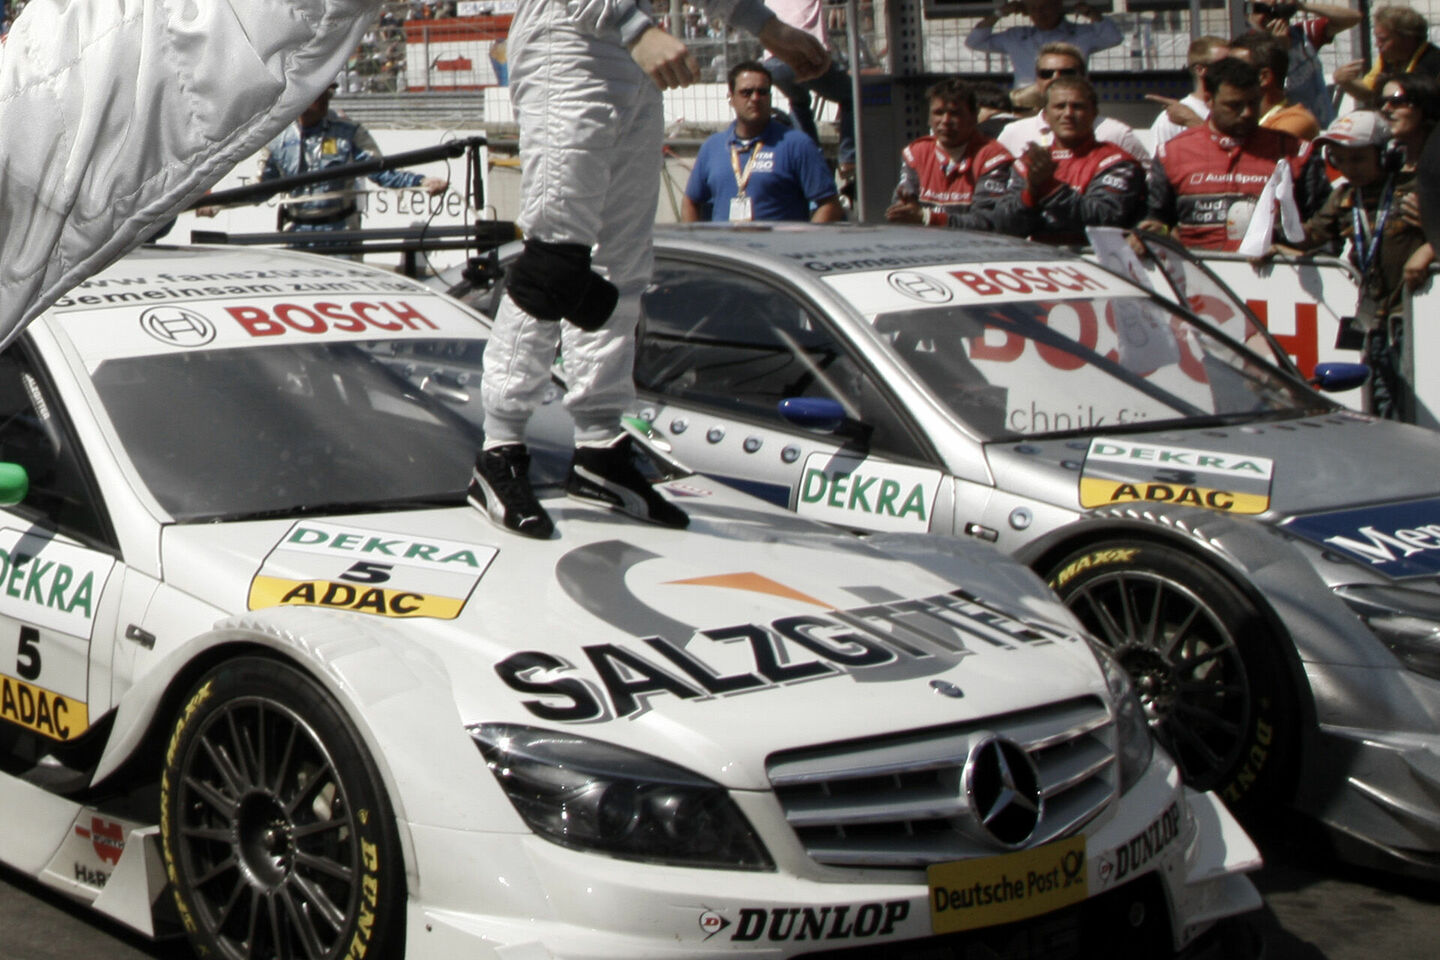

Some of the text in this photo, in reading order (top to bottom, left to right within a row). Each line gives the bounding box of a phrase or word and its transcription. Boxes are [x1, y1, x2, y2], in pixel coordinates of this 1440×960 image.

[948, 265, 1109, 296] BOSCH
[224, 301, 439, 338] BOSCH
[1092, 443, 1265, 475] DEKRA
[801, 467, 927, 522] DEKRA
[1111, 483, 1235, 510] ADAC
[286, 527, 481, 569] DEKRA
[1058, 547, 1142, 589] MAXX
[338, 561, 395, 584] 5
[280, 582, 425, 616] ADAC
[16, 624, 42, 682] 5
[1, 677, 71, 740] ADAC
[1113, 801, 1182, 880] DUNLOP
[934, 866, 1059, 913] Deutsche Post
[730, 900, 911, 941] DUNLOP
